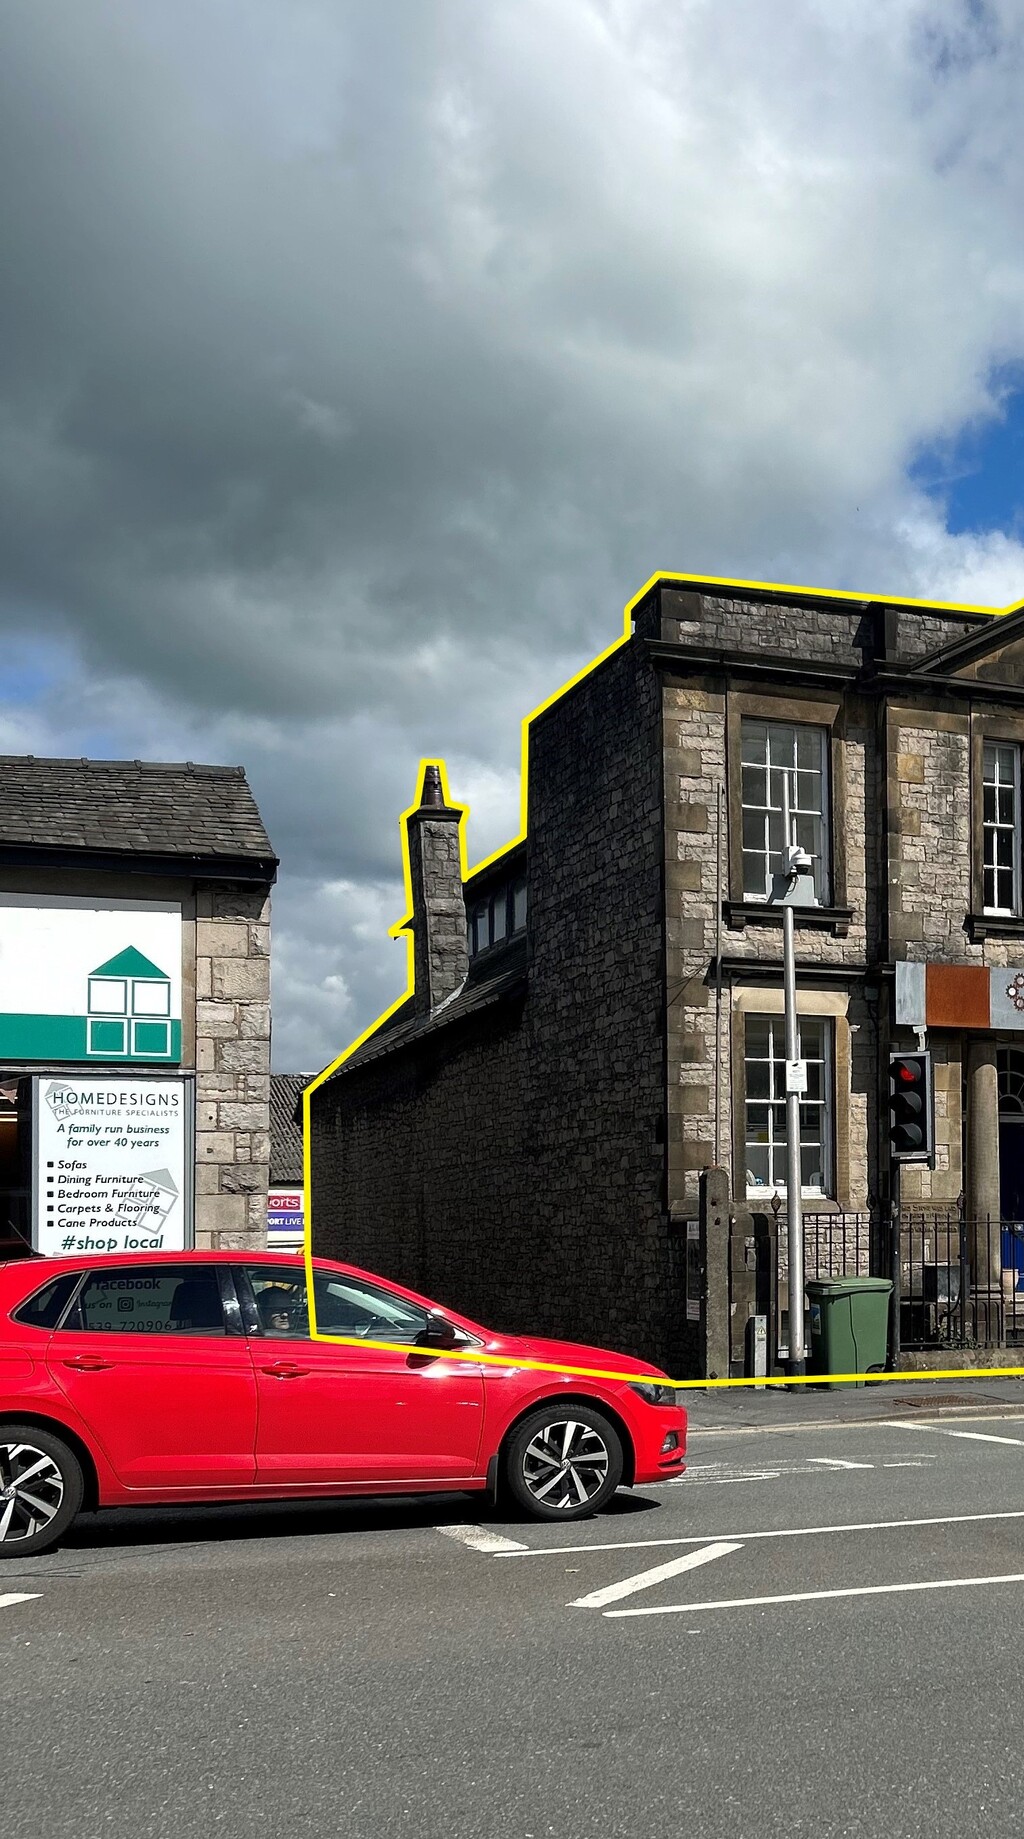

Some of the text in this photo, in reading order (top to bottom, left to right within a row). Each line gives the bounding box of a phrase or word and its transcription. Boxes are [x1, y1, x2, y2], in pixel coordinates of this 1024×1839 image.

[53, 1092, 179, 1106] HOMEDESIGNS
[126, 1109, 179, 1117] SPECIALISTS
[57, 1123, 170, 1136] A family run business
[67, 1137, 160, 1150] for over 40 years
[57, 1160, 88, 1171] Sofas
[57, 1174, 144, 1187] Dining Furniture
[57, 1189, 160, 1199] Bedroom Furniture
[269, 1197, 299, 1207] orts
[57, 1203, 161, 1215] Carpets & Flooring
[57, 1217, 138, 1228] Cane Products
[267, 1217, 284, 1225] ORT
[285, 1217, 301, 1226] LIVE
[61, 1234, 164, 1251] #shop local
[99, 1301, 112, 1309] on
[120, 1320, 172, 1332] 720906
